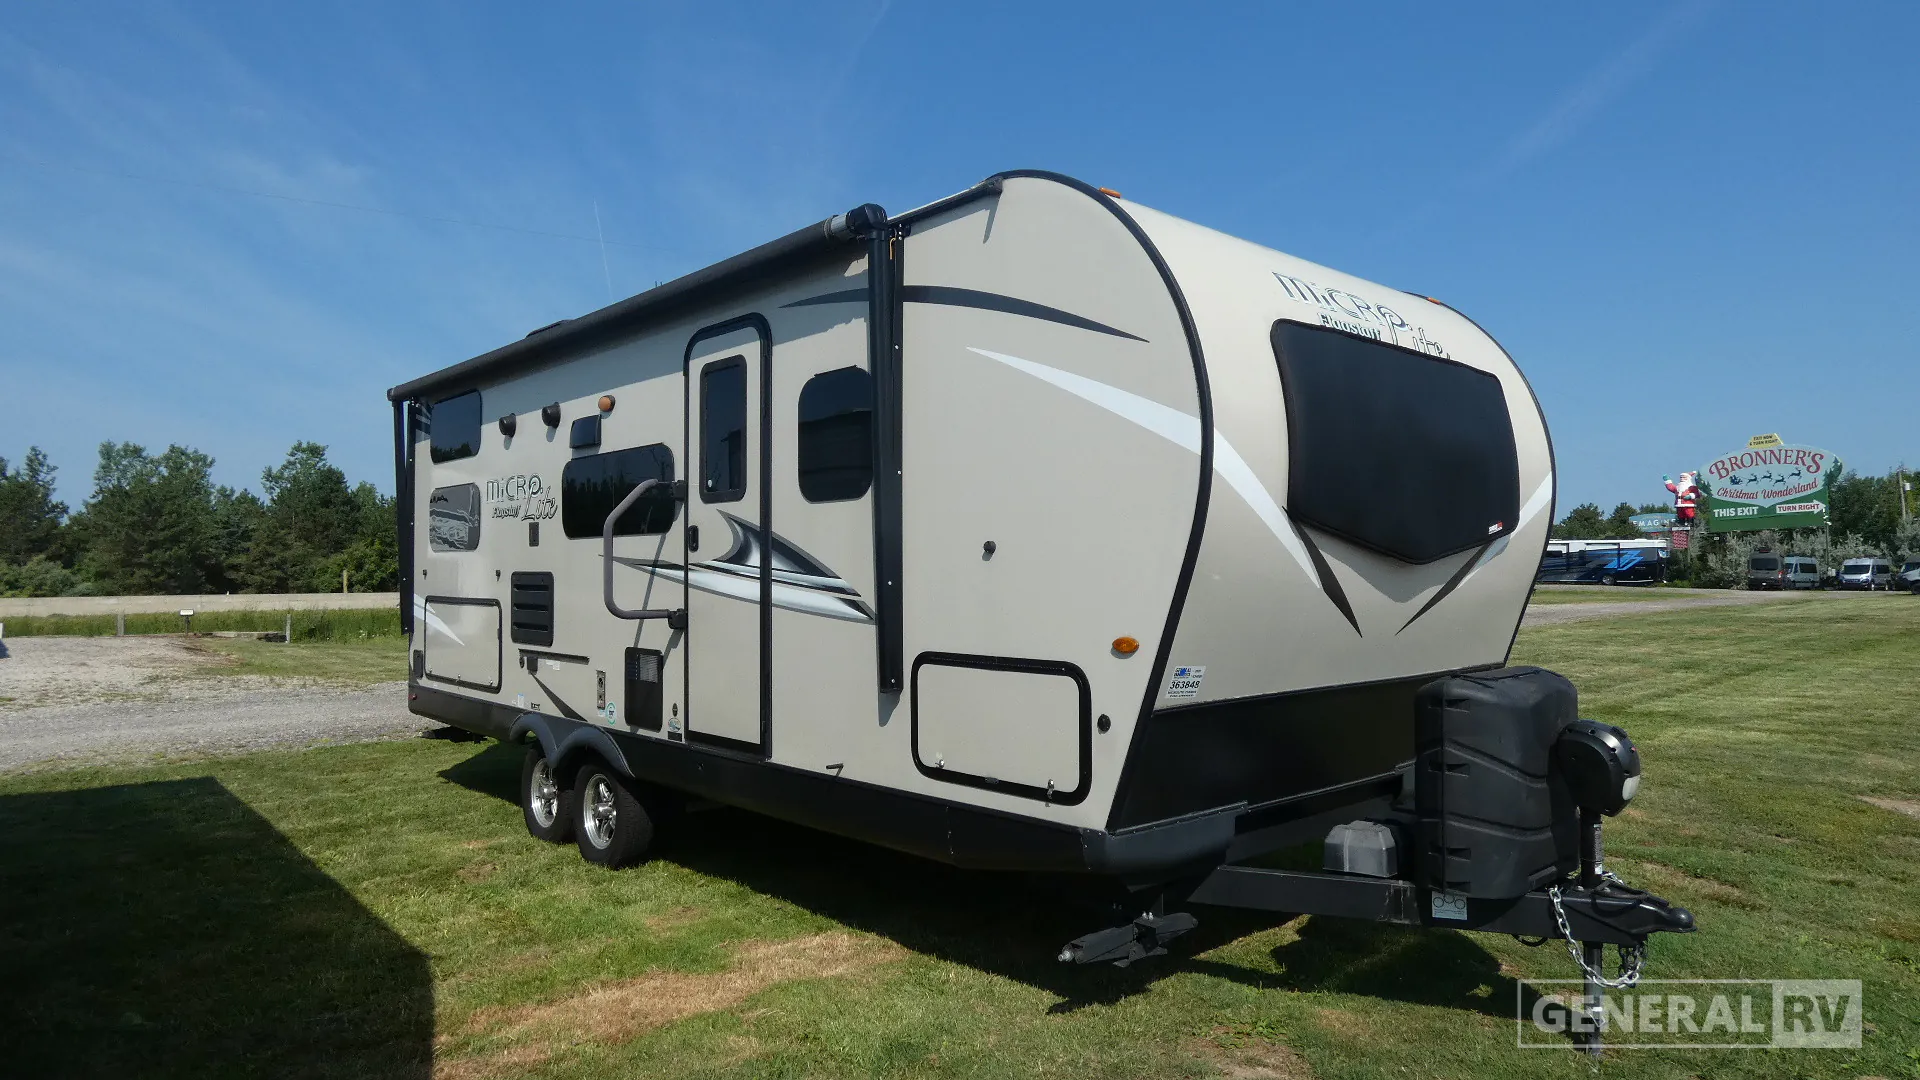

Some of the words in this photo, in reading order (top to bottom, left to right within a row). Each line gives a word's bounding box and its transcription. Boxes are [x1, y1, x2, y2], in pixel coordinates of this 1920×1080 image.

[1709, 449, 1824, 480] BRONNER'S
[1717, 487, 1758, 500] Christmas
[1761, 478, 1818, 499] Wonderland
[1713, 509, 1736, 518] THIS
[1737, 506, 1759, 516] EXIT
[1798, 503, 1820, 511] RIGHT
